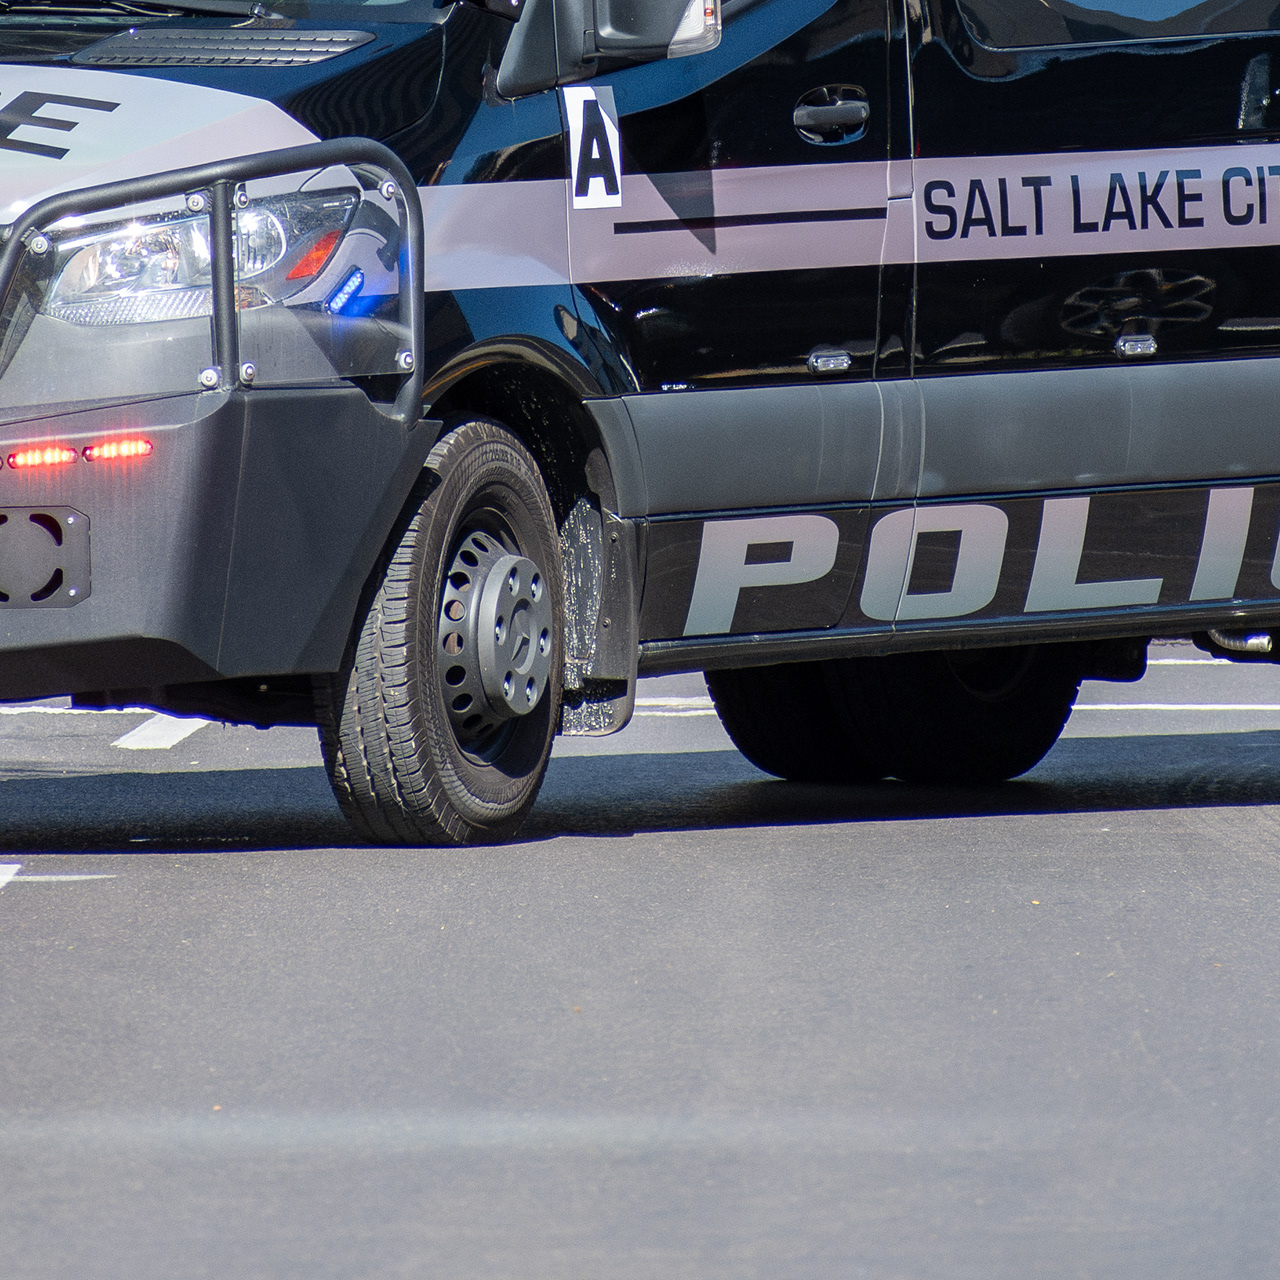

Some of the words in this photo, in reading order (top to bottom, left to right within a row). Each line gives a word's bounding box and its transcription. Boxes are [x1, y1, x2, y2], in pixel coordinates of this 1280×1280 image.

[574, 99, 620, 197] A
[923, 175, 1052, 241] SALT
[1071, 169, 1205, 234] LAKE
